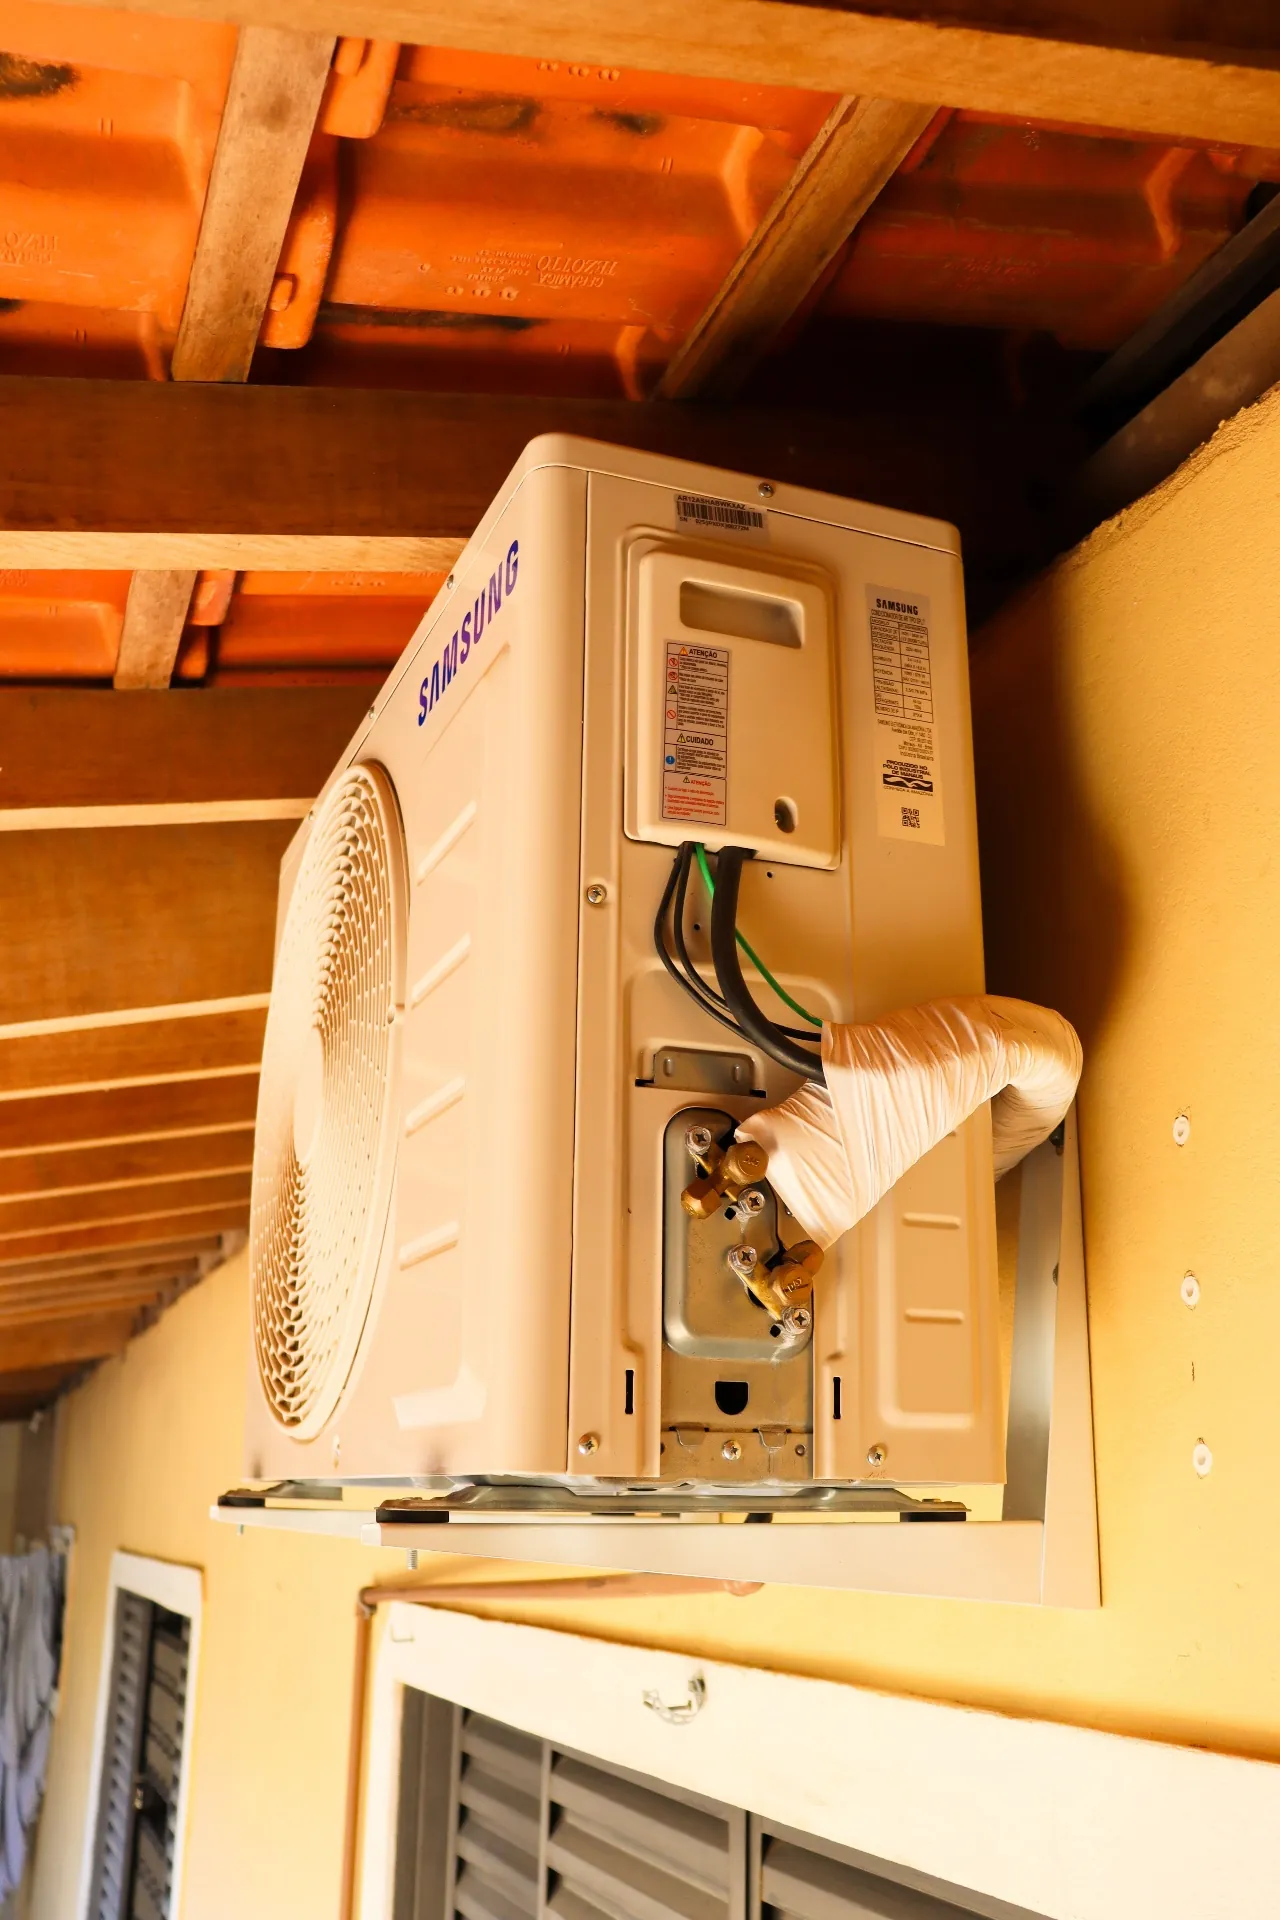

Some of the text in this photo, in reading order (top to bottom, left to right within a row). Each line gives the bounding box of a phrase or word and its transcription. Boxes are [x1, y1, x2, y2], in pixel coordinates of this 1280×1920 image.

[535, 255, 618, 276] TEZOTTO
[876, 598, 918, 615] SAMSUNG
[418, 540, 519, 727] SAMSUNG
[689, 648, 718, 659] ATENÇÃO
[686, 736, 714, 746] CUIDADO
[886, 760, 918, 770] PRODUZIDO
[900, 772, 924, 780] MANAUS
